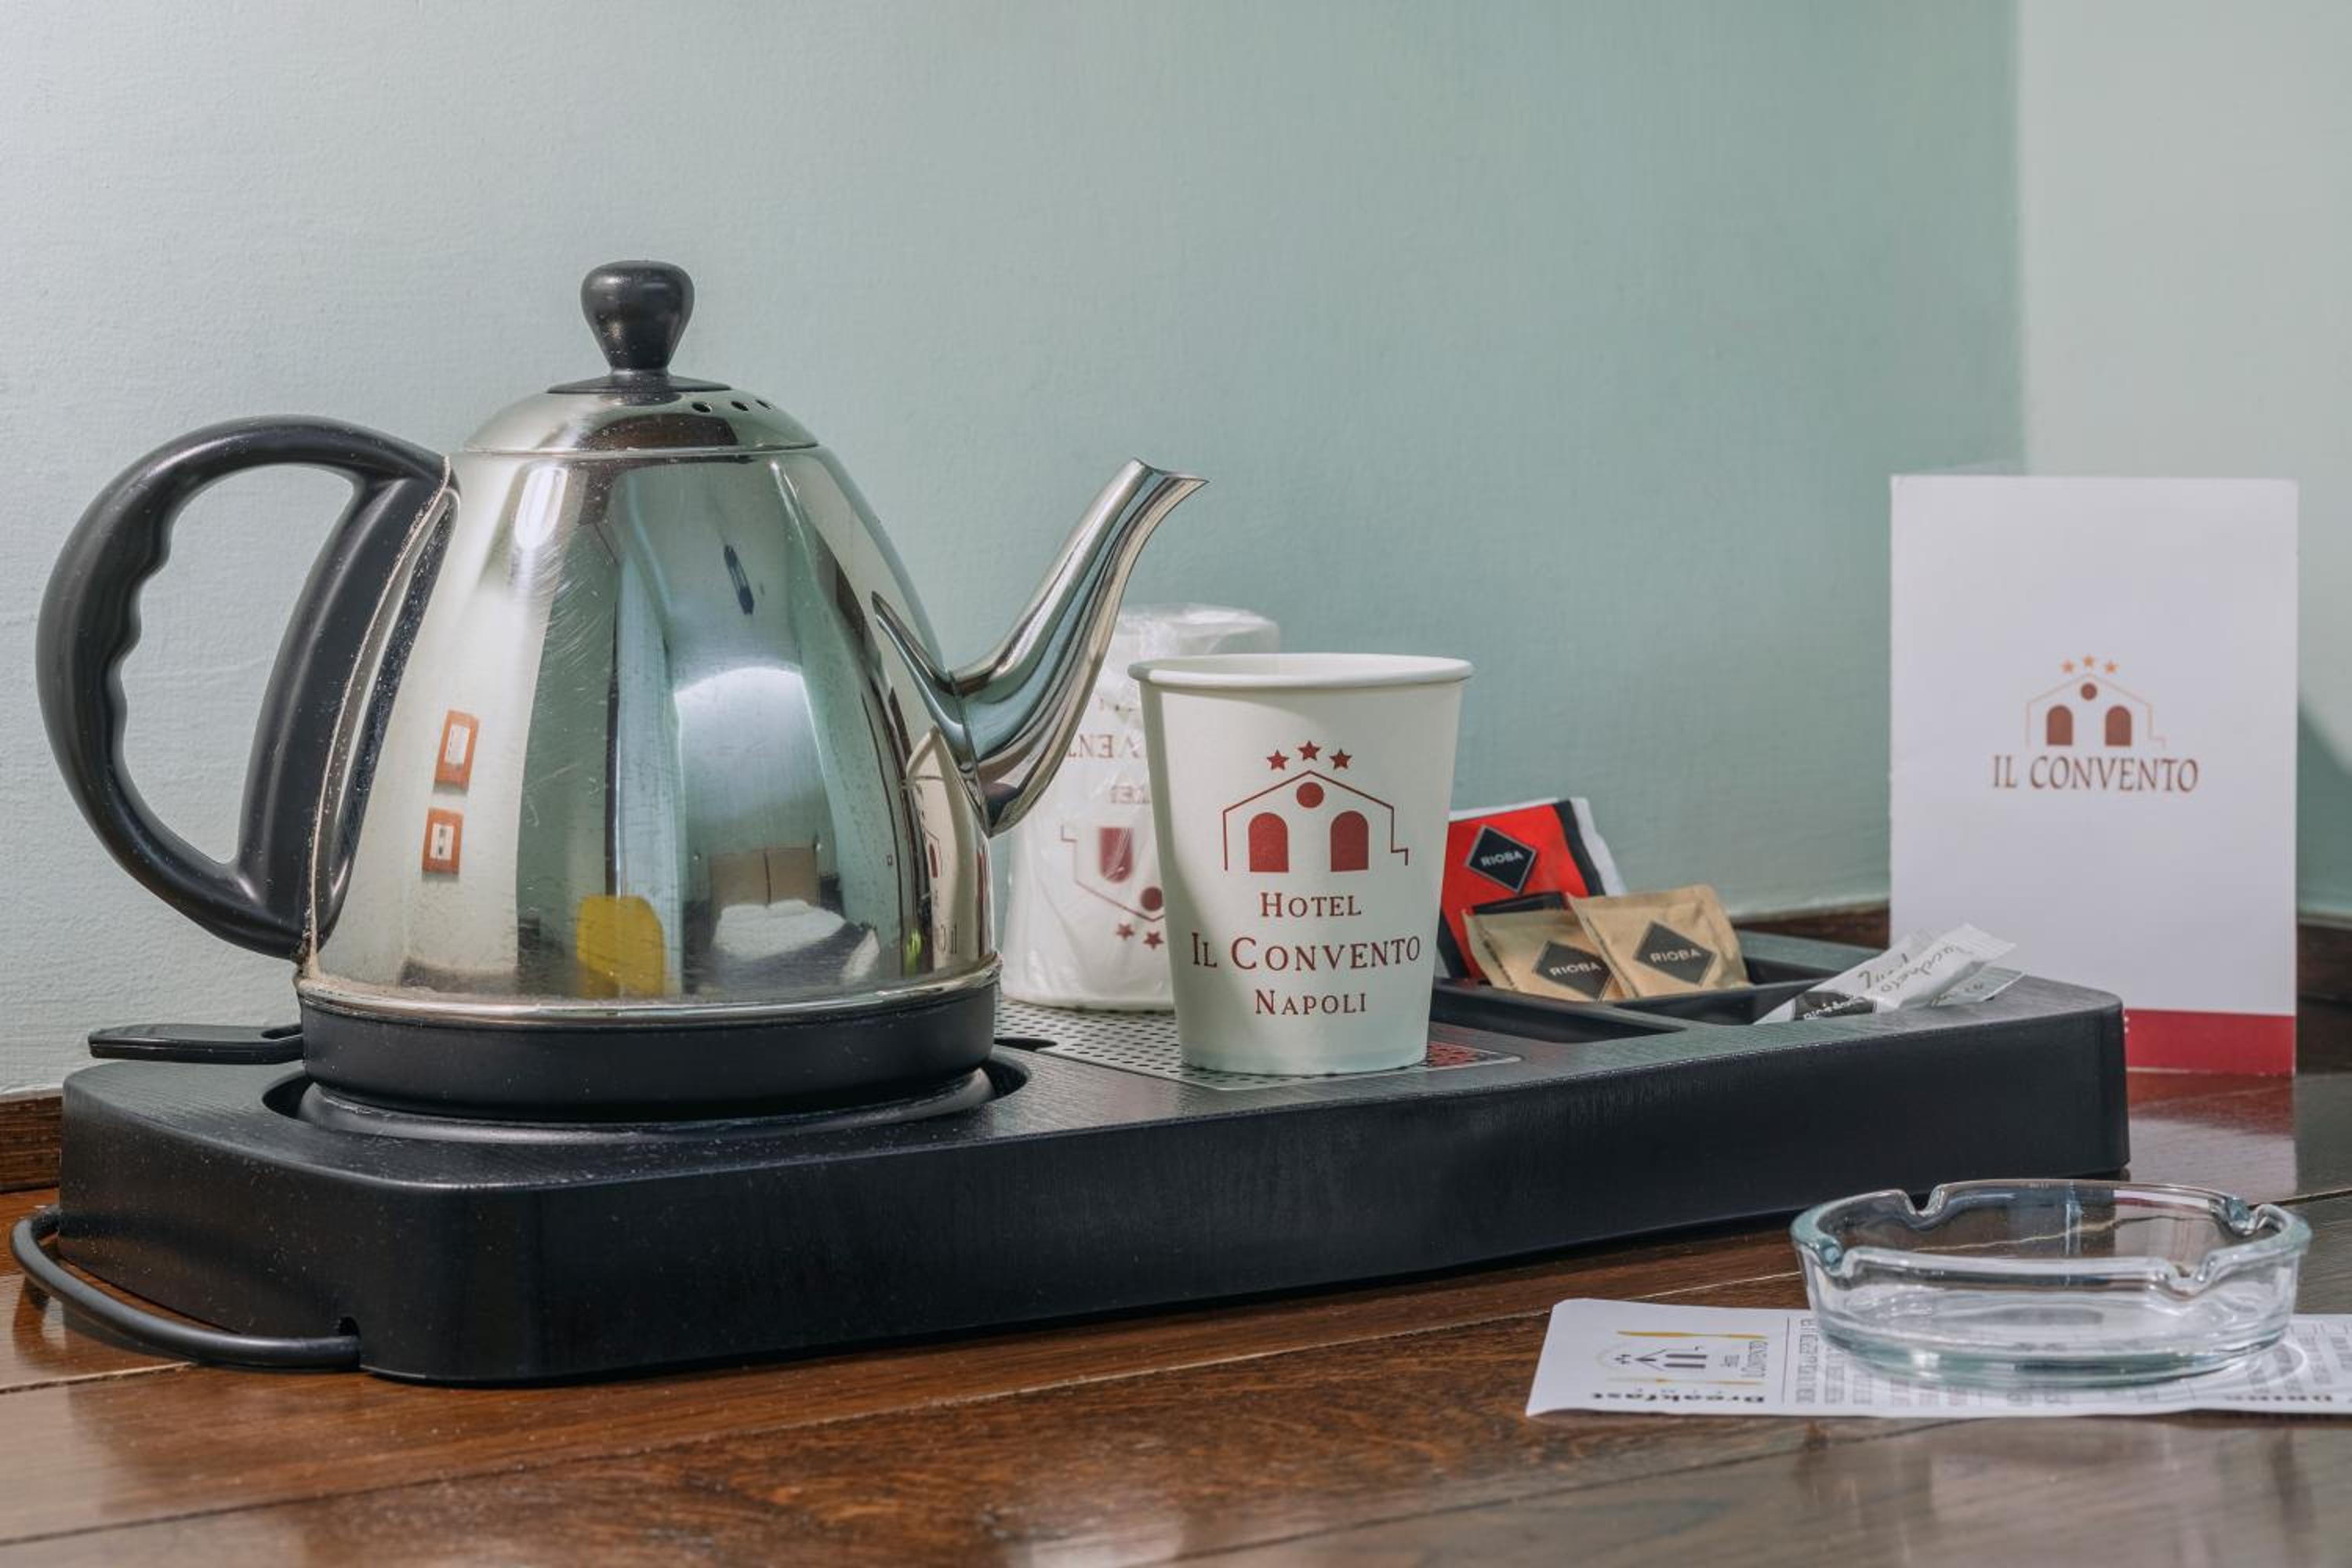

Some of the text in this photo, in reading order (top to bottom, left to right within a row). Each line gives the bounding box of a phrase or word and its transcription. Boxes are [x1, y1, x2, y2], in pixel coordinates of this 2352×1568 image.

[1991, 755, 2199, 793] IL CONVENTO
[1480, 850, 1525, 867] RIOBA
[1261, 891, 1363, 918] HOTEL
[1192, 933, 1421, 972] IL CONVENTO
[1649, 948, 1703, 964] RIOBA
[1548, 961, 1602, 977] RIOBA
[1255, 989, 1367, 1016] NAPOLI
